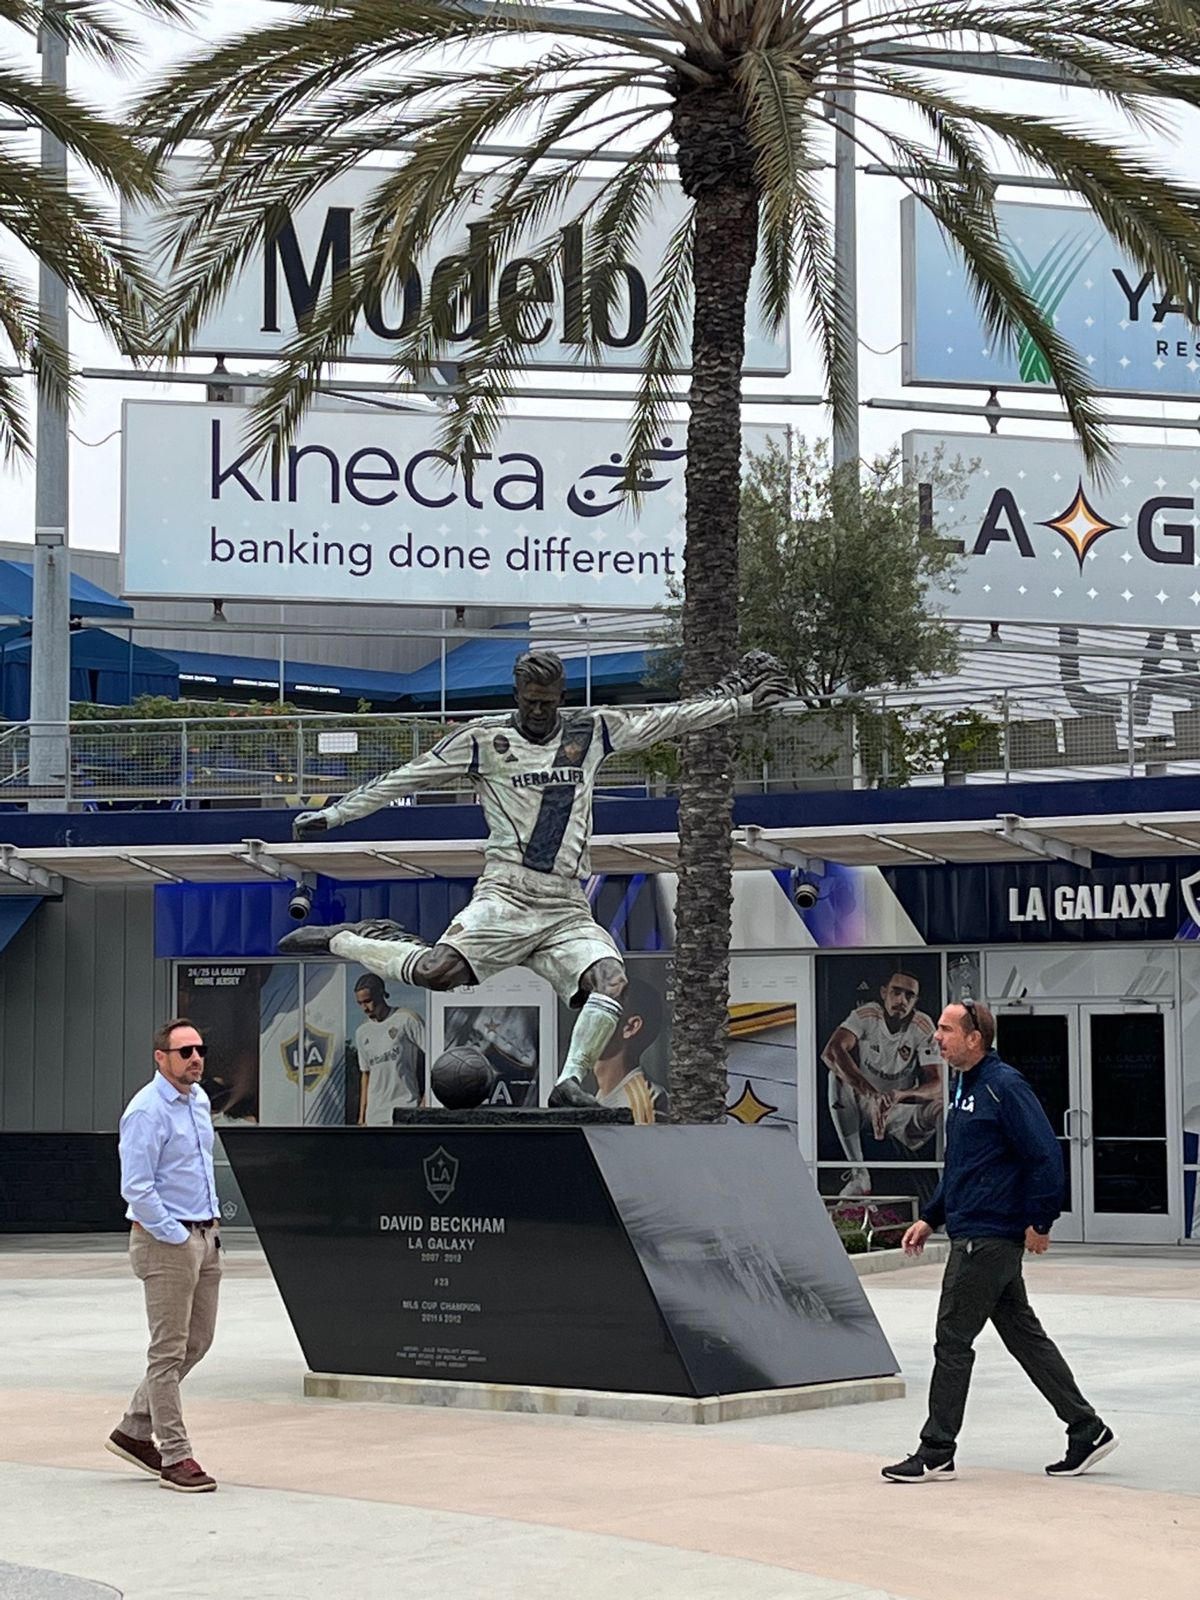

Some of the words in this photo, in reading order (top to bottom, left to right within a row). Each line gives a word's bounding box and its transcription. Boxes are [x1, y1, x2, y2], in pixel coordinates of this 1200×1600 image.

[260, 205, 648, 348] Modelo
[211, 419, 545, 511] kinecta
[210, 526, 372, 577] banking
[388, 532, 491, 571] done
[505, 536, 676, 576] different
[1008, 887, 1046, 922] LA
[1054, 882, 1171, 921] GALAXY
[431, 1167, 451, 1182] LA
[380, 1215, 424, 1231] DAVID
[430, 1216, 505, 1234] BECKHAM
[408, 1237, 423, 1249] LA
[428, 1237, 475, 1251] GALAXY
[402, 1300, 419, 1310] MLS
[421, 1301, 437, 1311] CUP
[440, 1301, 481, 1312] CHAMPION
